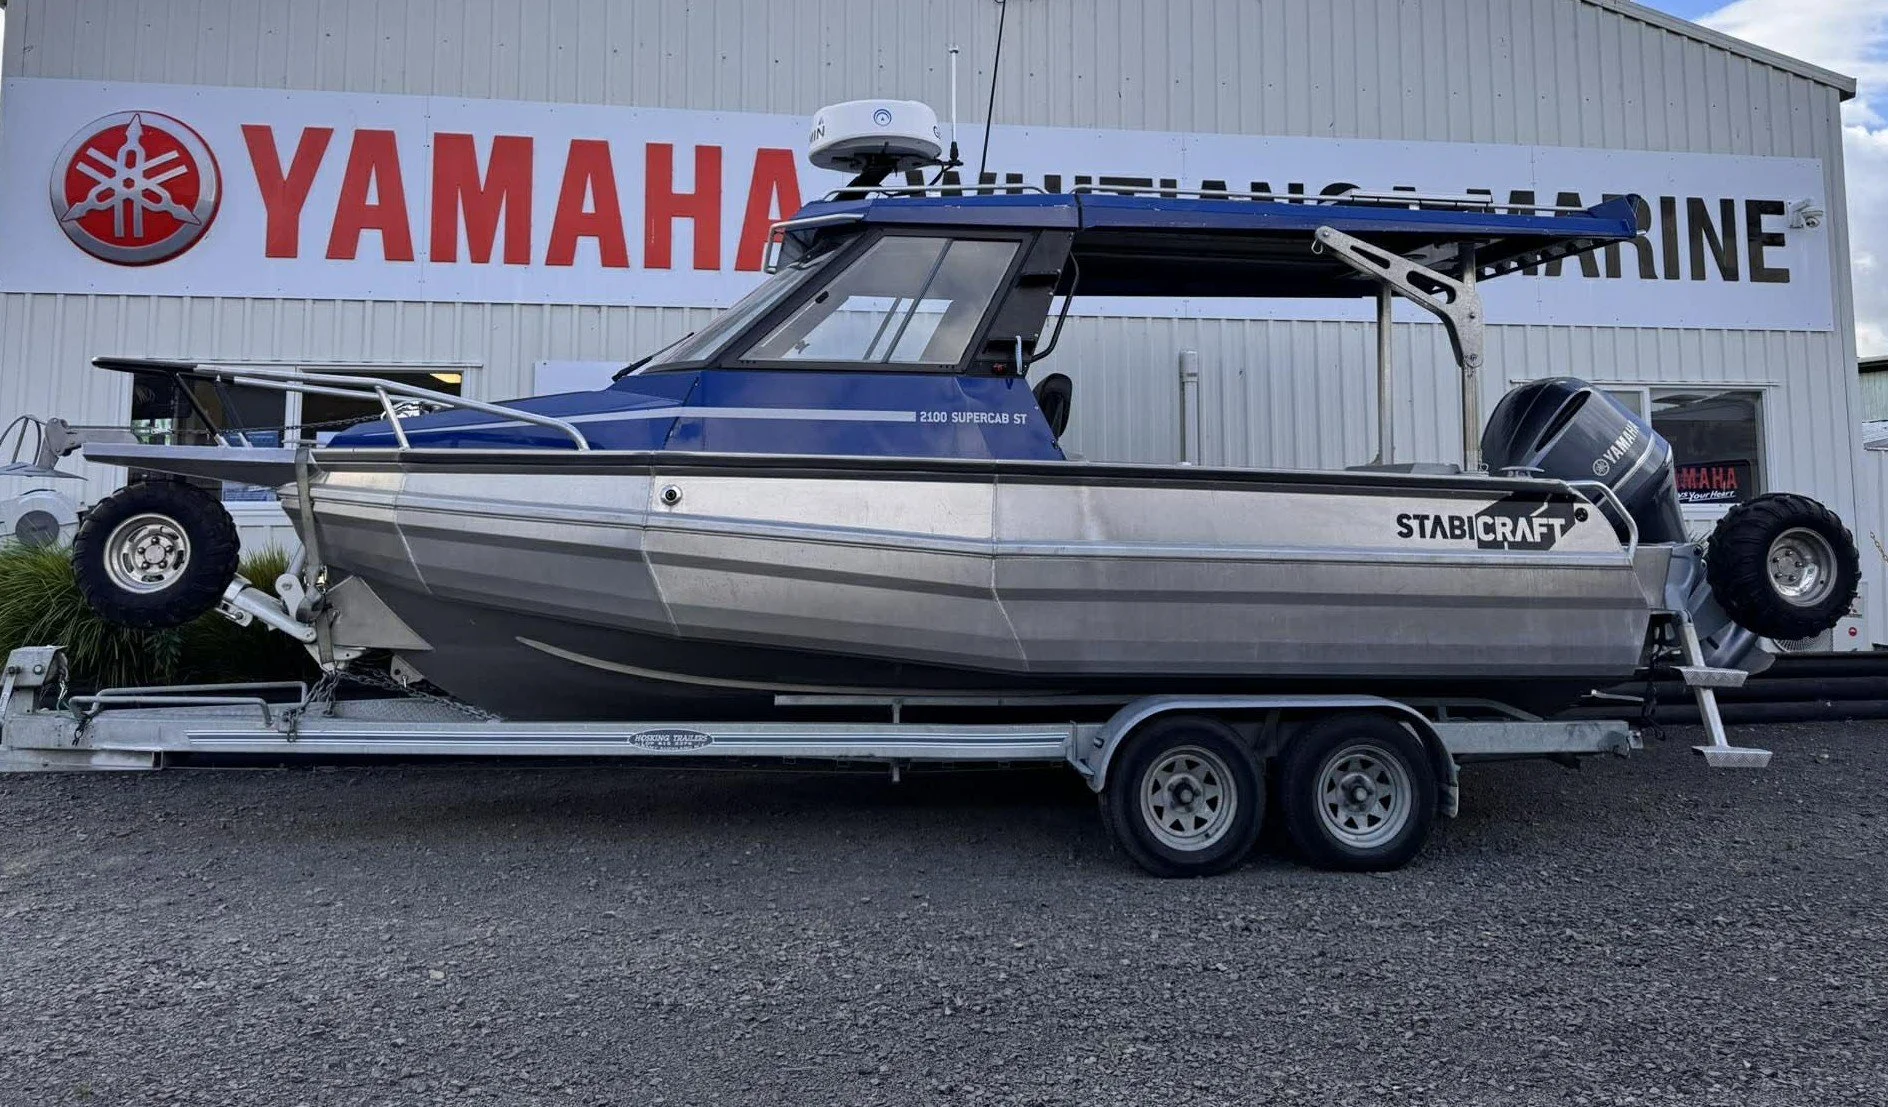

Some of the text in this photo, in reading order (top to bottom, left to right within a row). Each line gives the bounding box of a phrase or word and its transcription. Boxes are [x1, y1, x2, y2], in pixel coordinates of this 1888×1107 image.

[240, 124, 800, 272] YAMAHA
[920, 411, 1027, 424] 2100 SUPERCAB ST
[1676, 467, 1738, 490] MAHA
[1396, 513, 1565, 543] STABICRAFT
[635, 734, 708, 742] HOSKING TRAILERS
